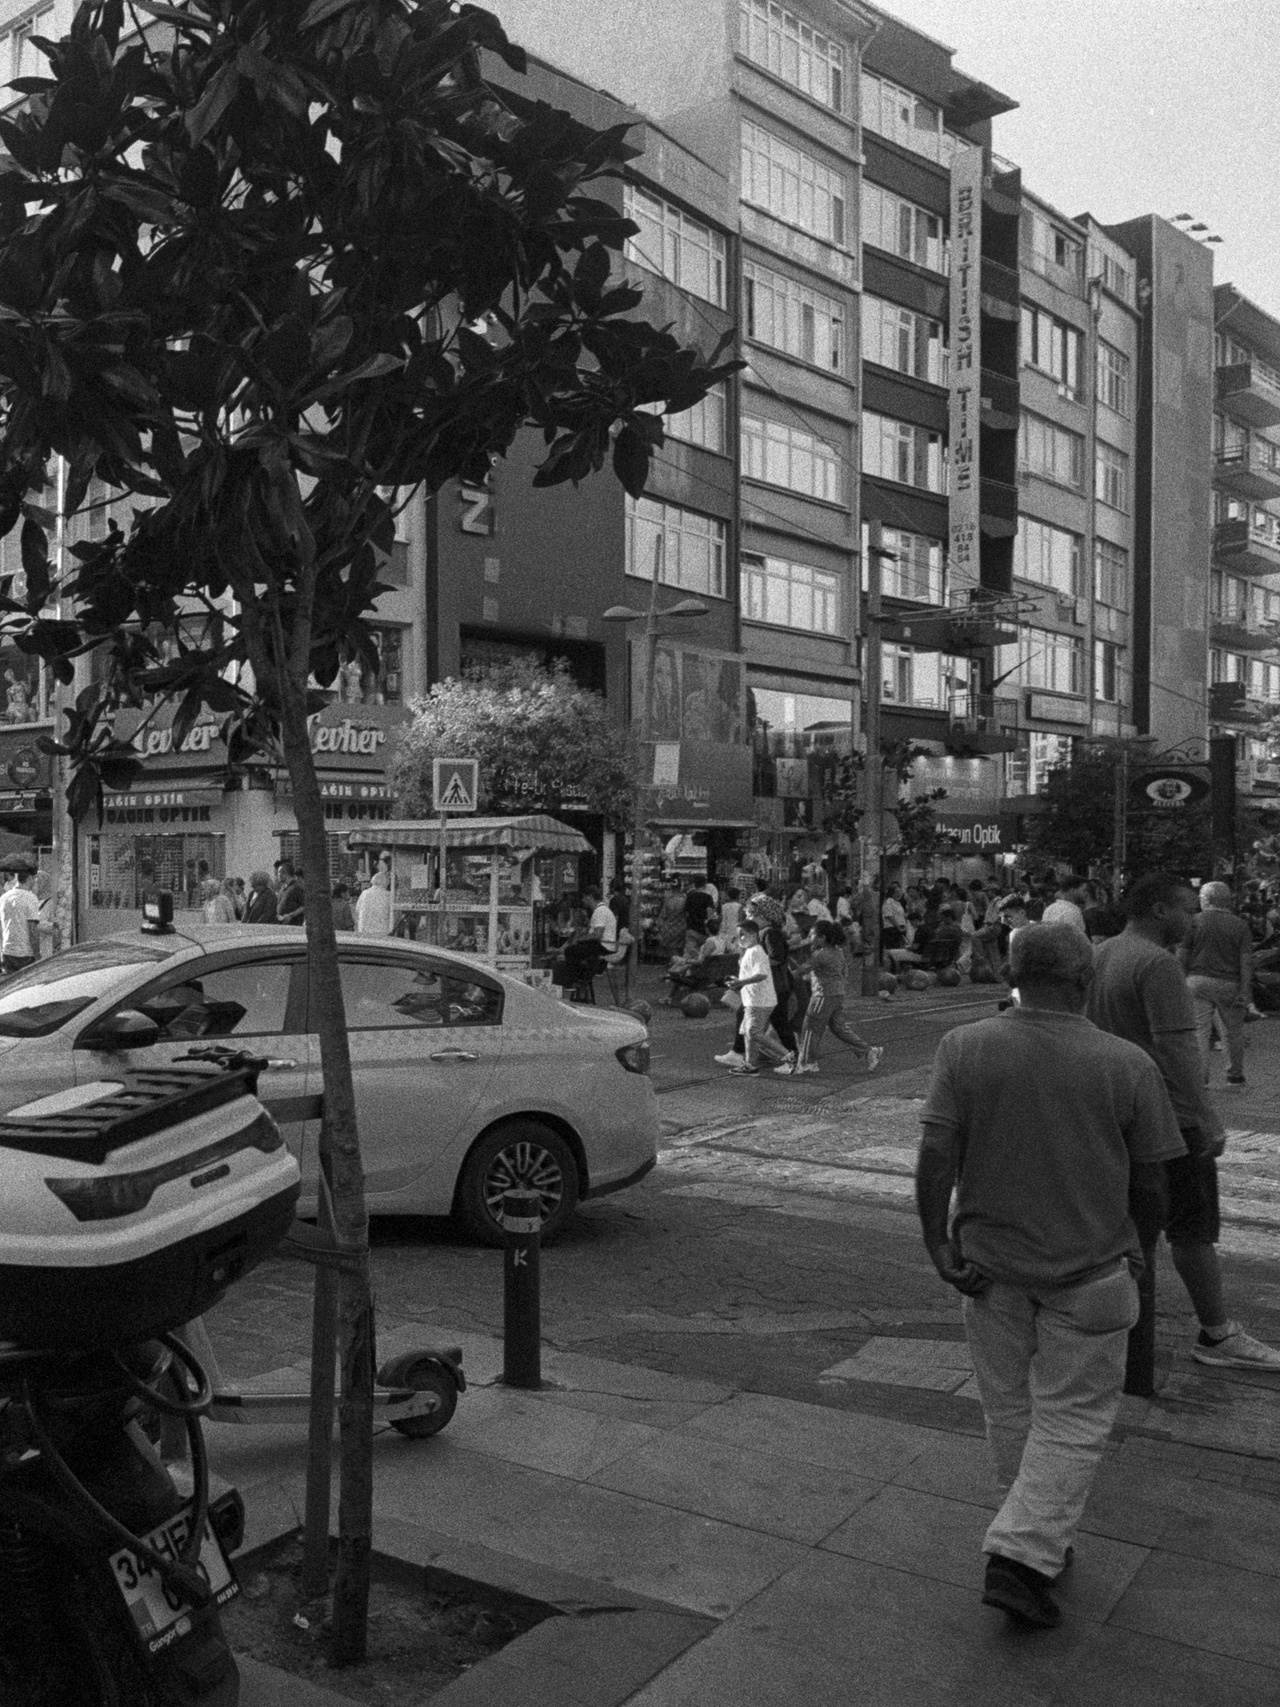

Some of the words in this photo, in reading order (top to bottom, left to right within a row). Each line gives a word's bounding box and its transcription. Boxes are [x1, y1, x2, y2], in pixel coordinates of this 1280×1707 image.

[957, 186, 973, 371] BRITISH
[955, 387, 972, 491] TIME
[973, 823, 1001, 849] Optik
